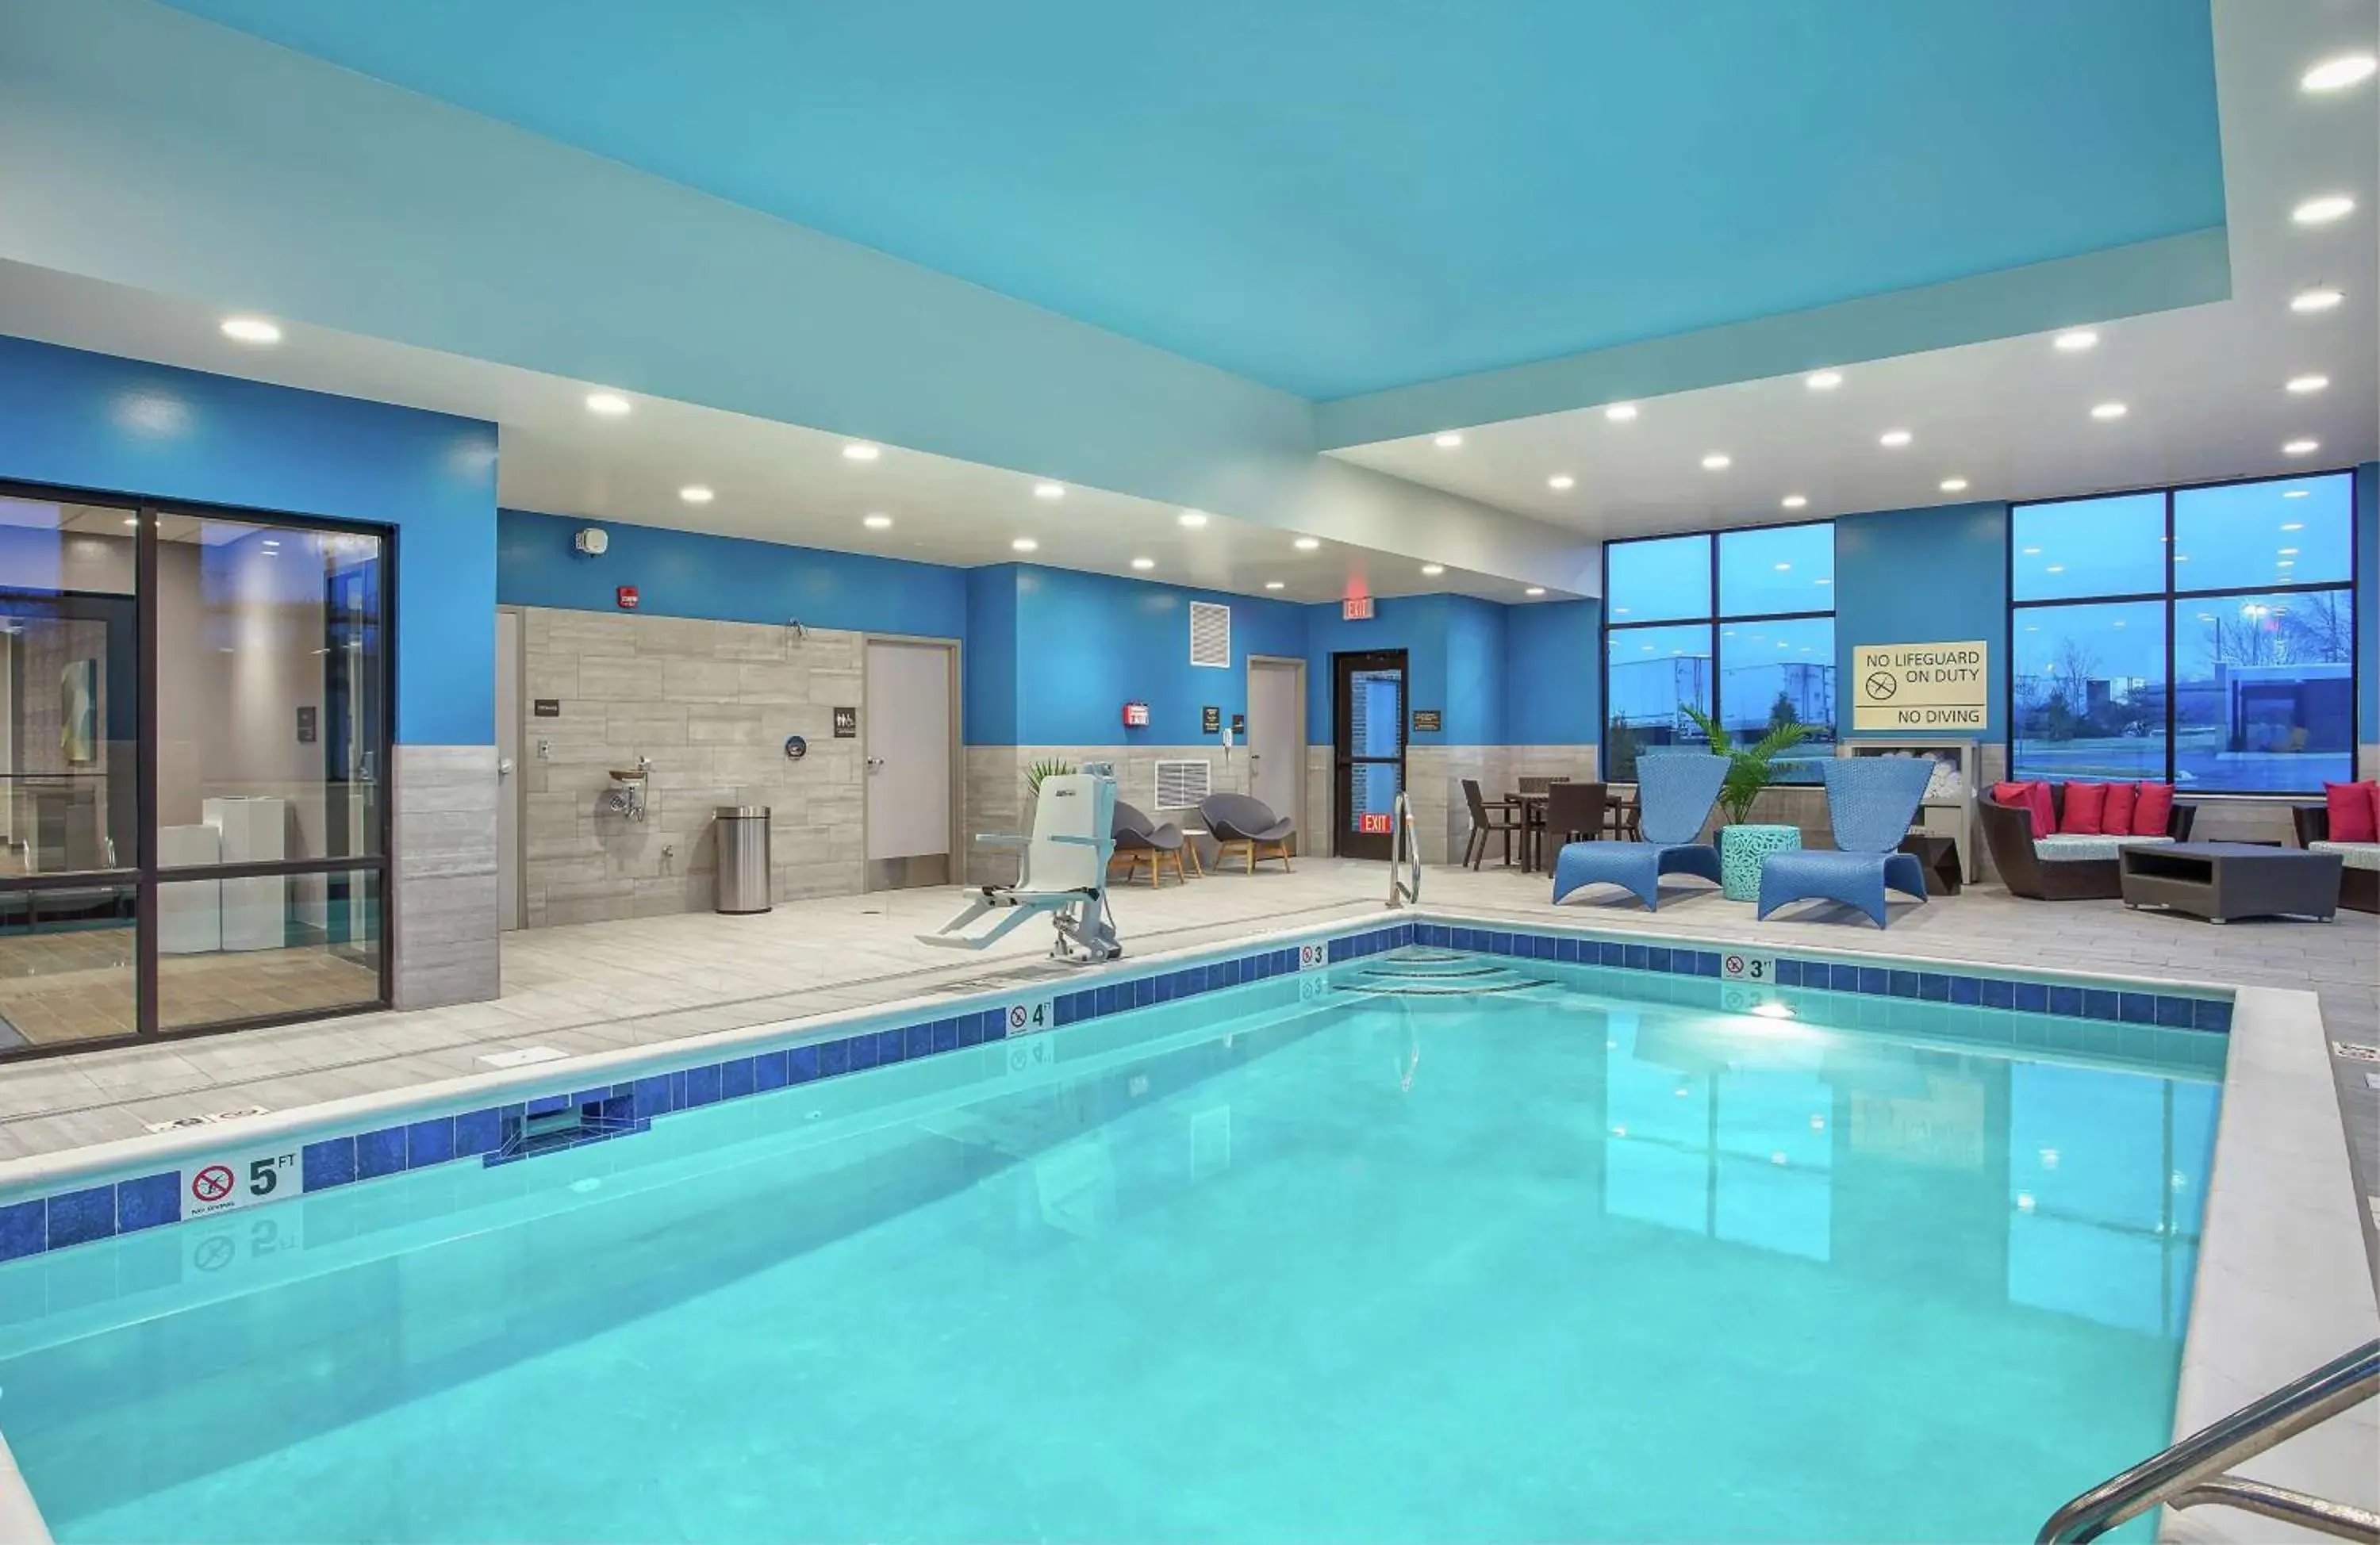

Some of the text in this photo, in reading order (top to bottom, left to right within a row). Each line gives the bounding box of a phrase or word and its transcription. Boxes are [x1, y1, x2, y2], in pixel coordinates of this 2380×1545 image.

[1348, 600, 1366, 616] EXIT
[1867, 651, 1979, 667] NO LIFEGUARD
[1906, 669, 1979, 683] ON DUTY
[1898, 710, 1979, 723] NO DIVING
[1365, 815, 1386, 830] EXIT
[1315, 945, 1322, 964] 3
[1750, 960, 1763, 978] 3
[1032, 1003, 1044, 1026] 4
[250, 1154, 296, 1196] 5 FT
